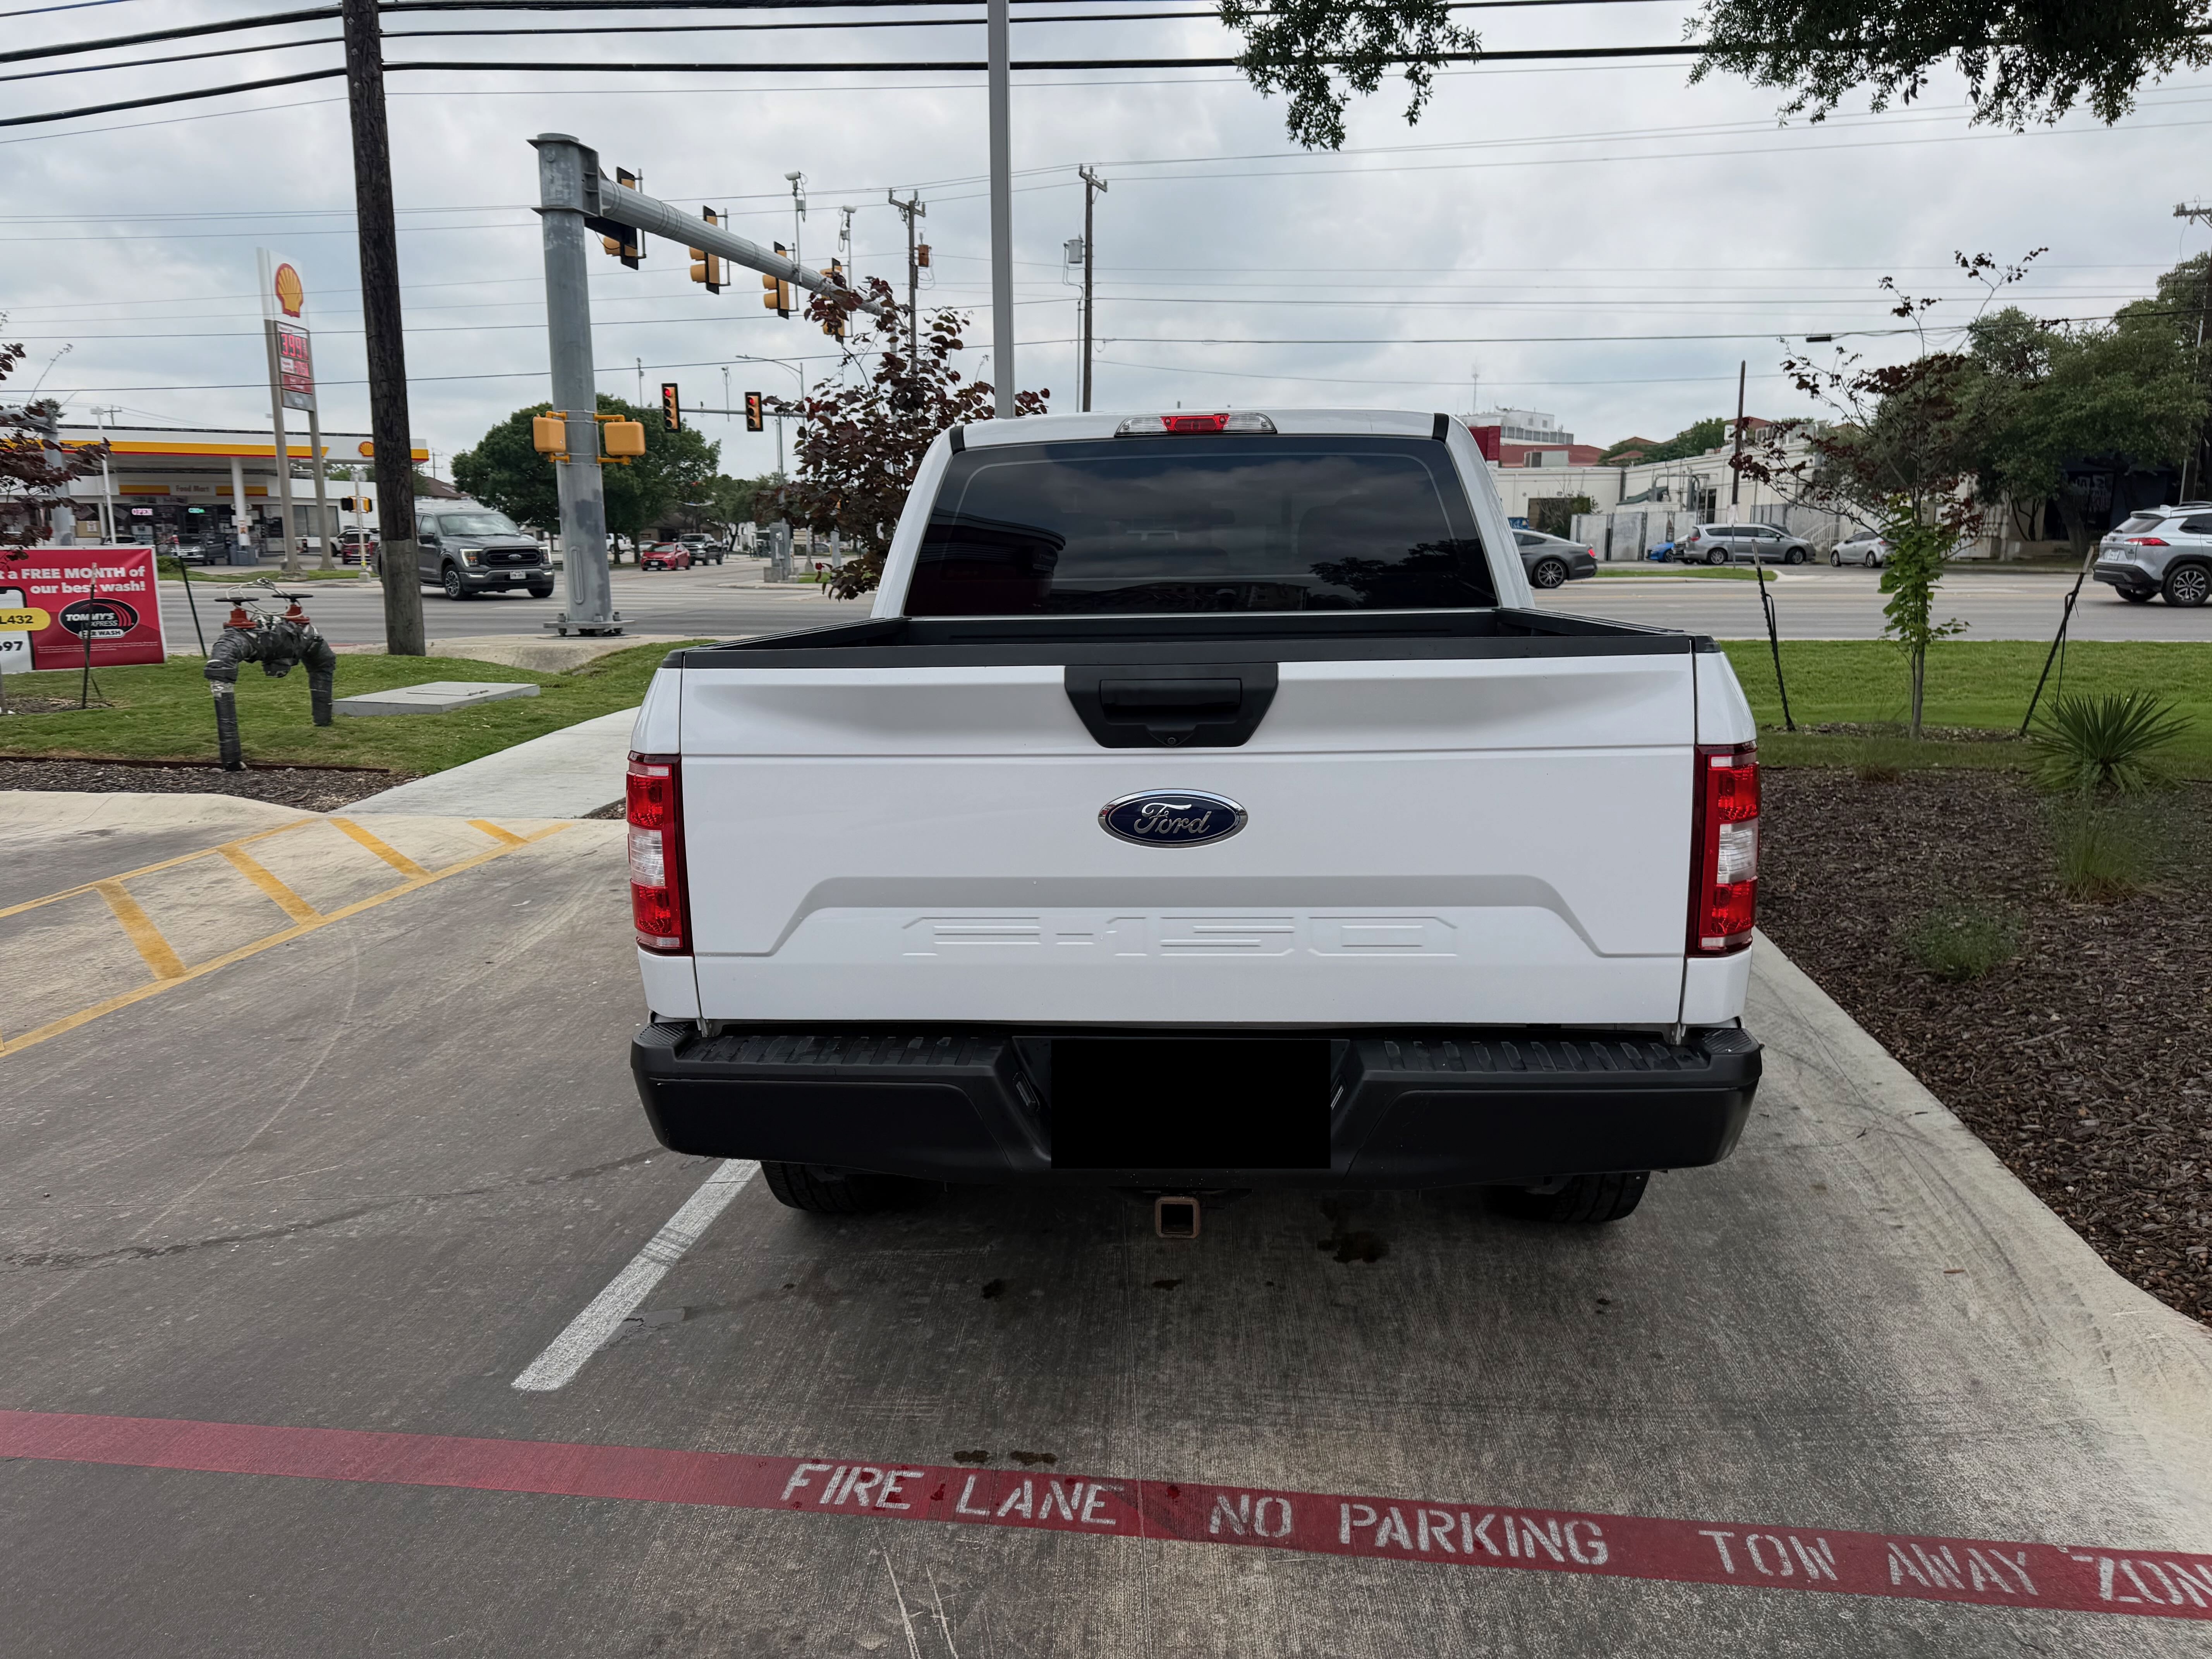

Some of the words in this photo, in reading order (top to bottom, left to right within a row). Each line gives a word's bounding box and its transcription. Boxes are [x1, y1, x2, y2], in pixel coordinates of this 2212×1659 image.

[7, 570, 18, 579] a
[21, 568, 61, 579] FREE
[64, 567, 126, 579] MONTH
[129, 566, 146, 577] of
[30, 585, 58, 594] our
[100, 580, 146, 592] wash!
[1134, 802, 1212, 834] Ford
[902, 915, 1458, 957] F-150
[780, 1462, 924, 1510] FIRE
[955, 1474, 1125, 1525] LANE
[1208, 1493, 1292, 1538] NO
[1338, 1502, 1609, 1566] PARKING
[1698, 1529, 1839, 1583] TOW
[1886, 1542, 2039, 1596] AWAY
